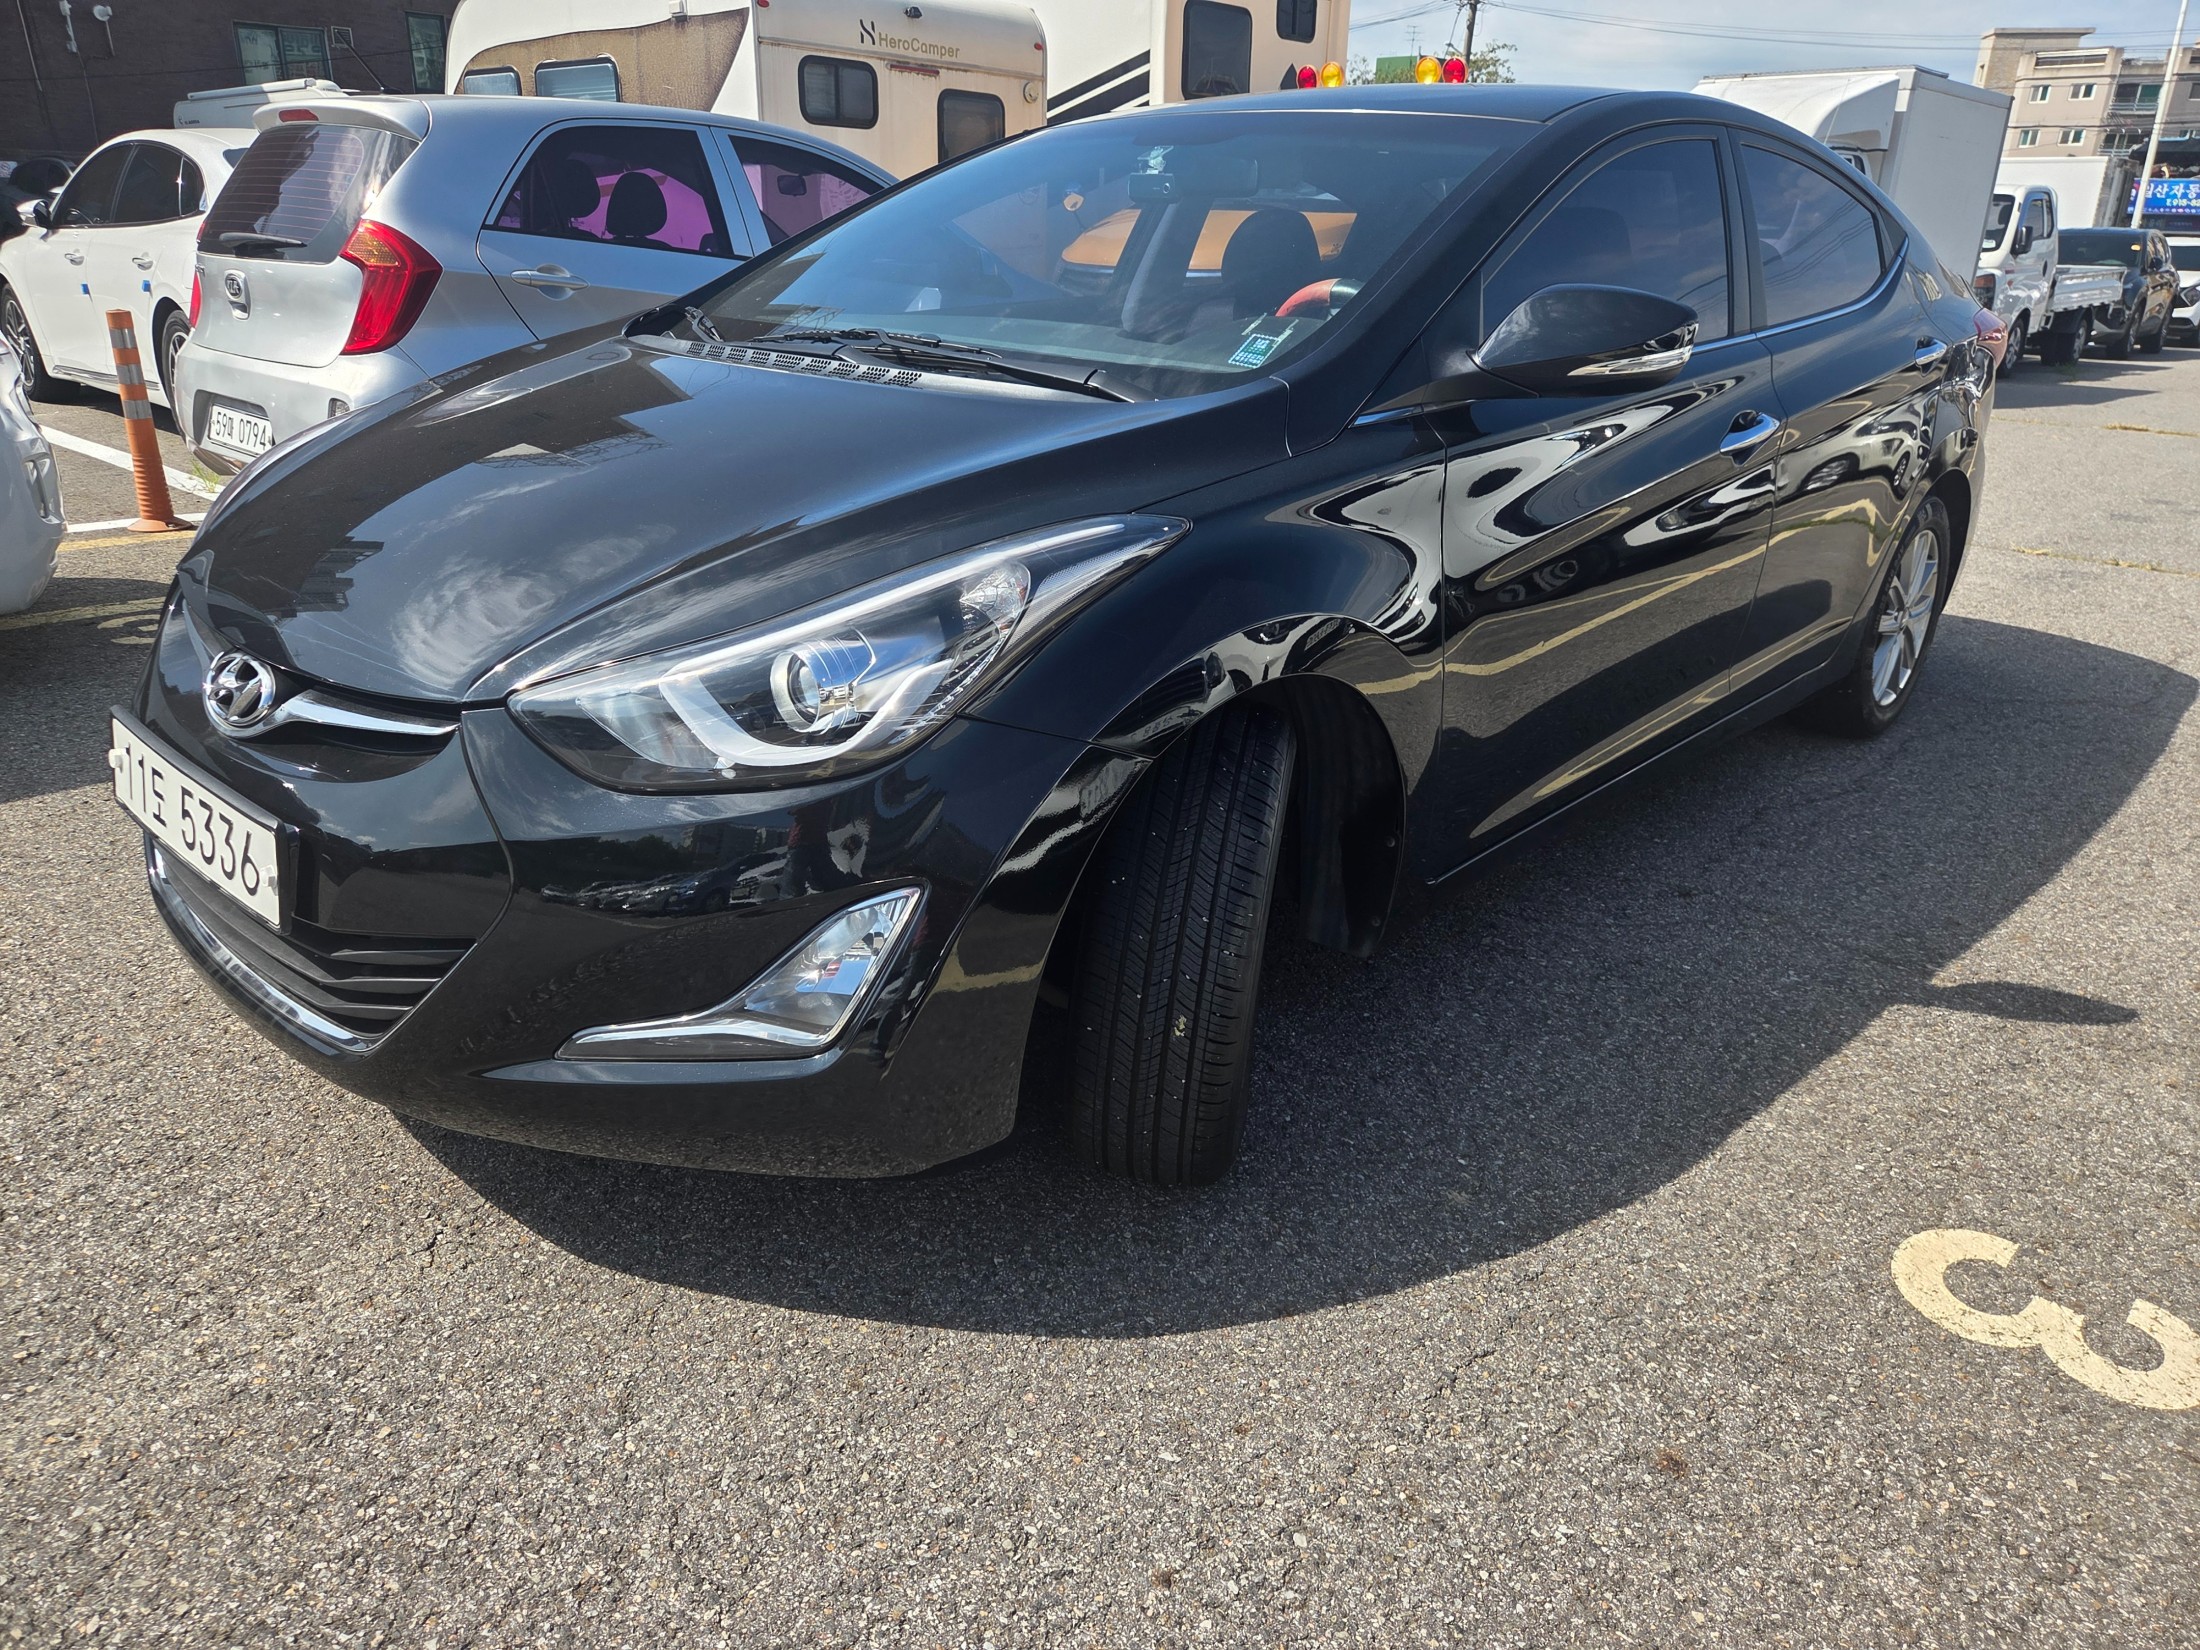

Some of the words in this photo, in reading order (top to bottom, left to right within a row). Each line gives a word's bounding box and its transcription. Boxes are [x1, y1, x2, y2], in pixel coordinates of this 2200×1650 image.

[879, 31, 960, 59] HeroCamper
[238, 418, 266, 451] 0794
[126, 742, 168, 828] 11도
[181, 785, 260, 897] 5336
